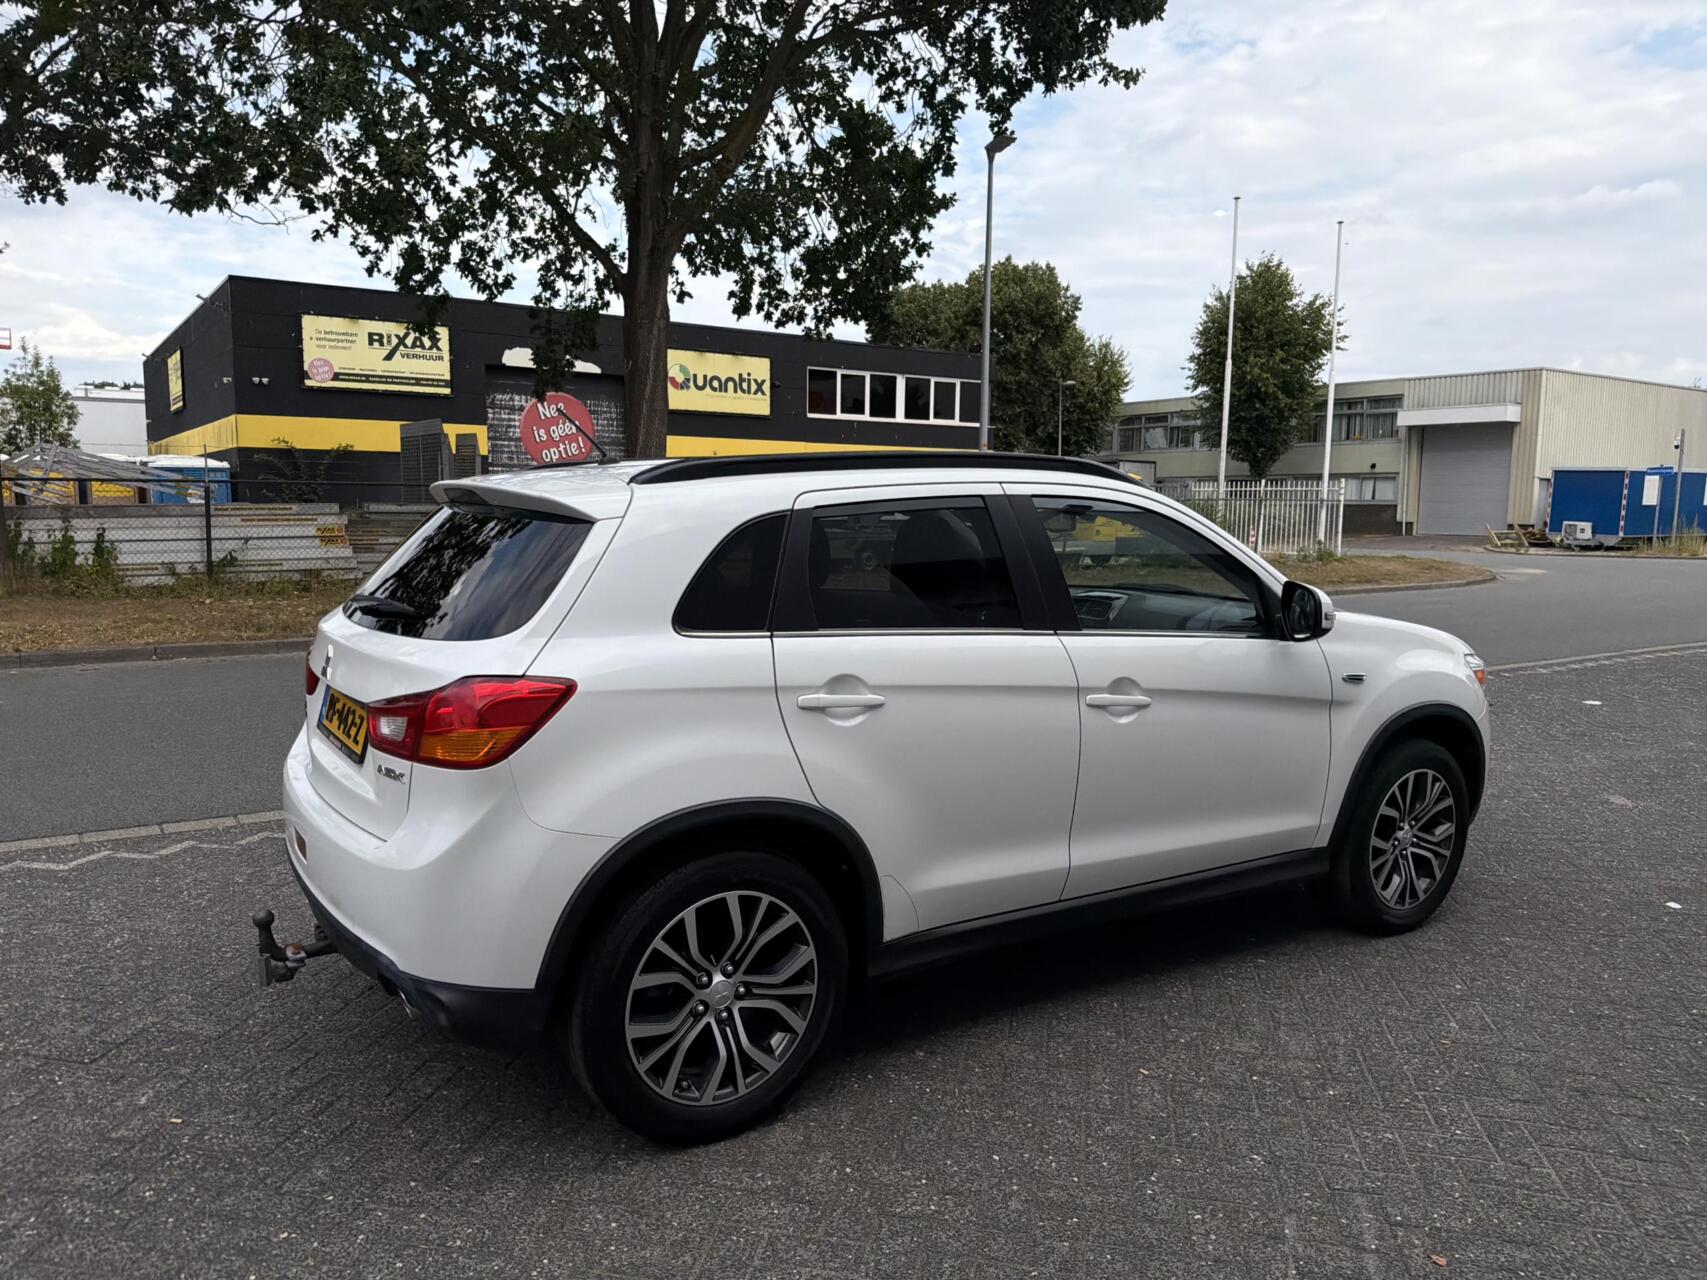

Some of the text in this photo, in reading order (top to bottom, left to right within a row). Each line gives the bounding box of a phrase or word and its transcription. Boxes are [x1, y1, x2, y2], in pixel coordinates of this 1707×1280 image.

[315, 336, 357, 344] verhuurpartner
[400, 352, 444, 362] VERHUUR
[537, 401, 566, 420] Nee
[532, 426, 547, 443] is
